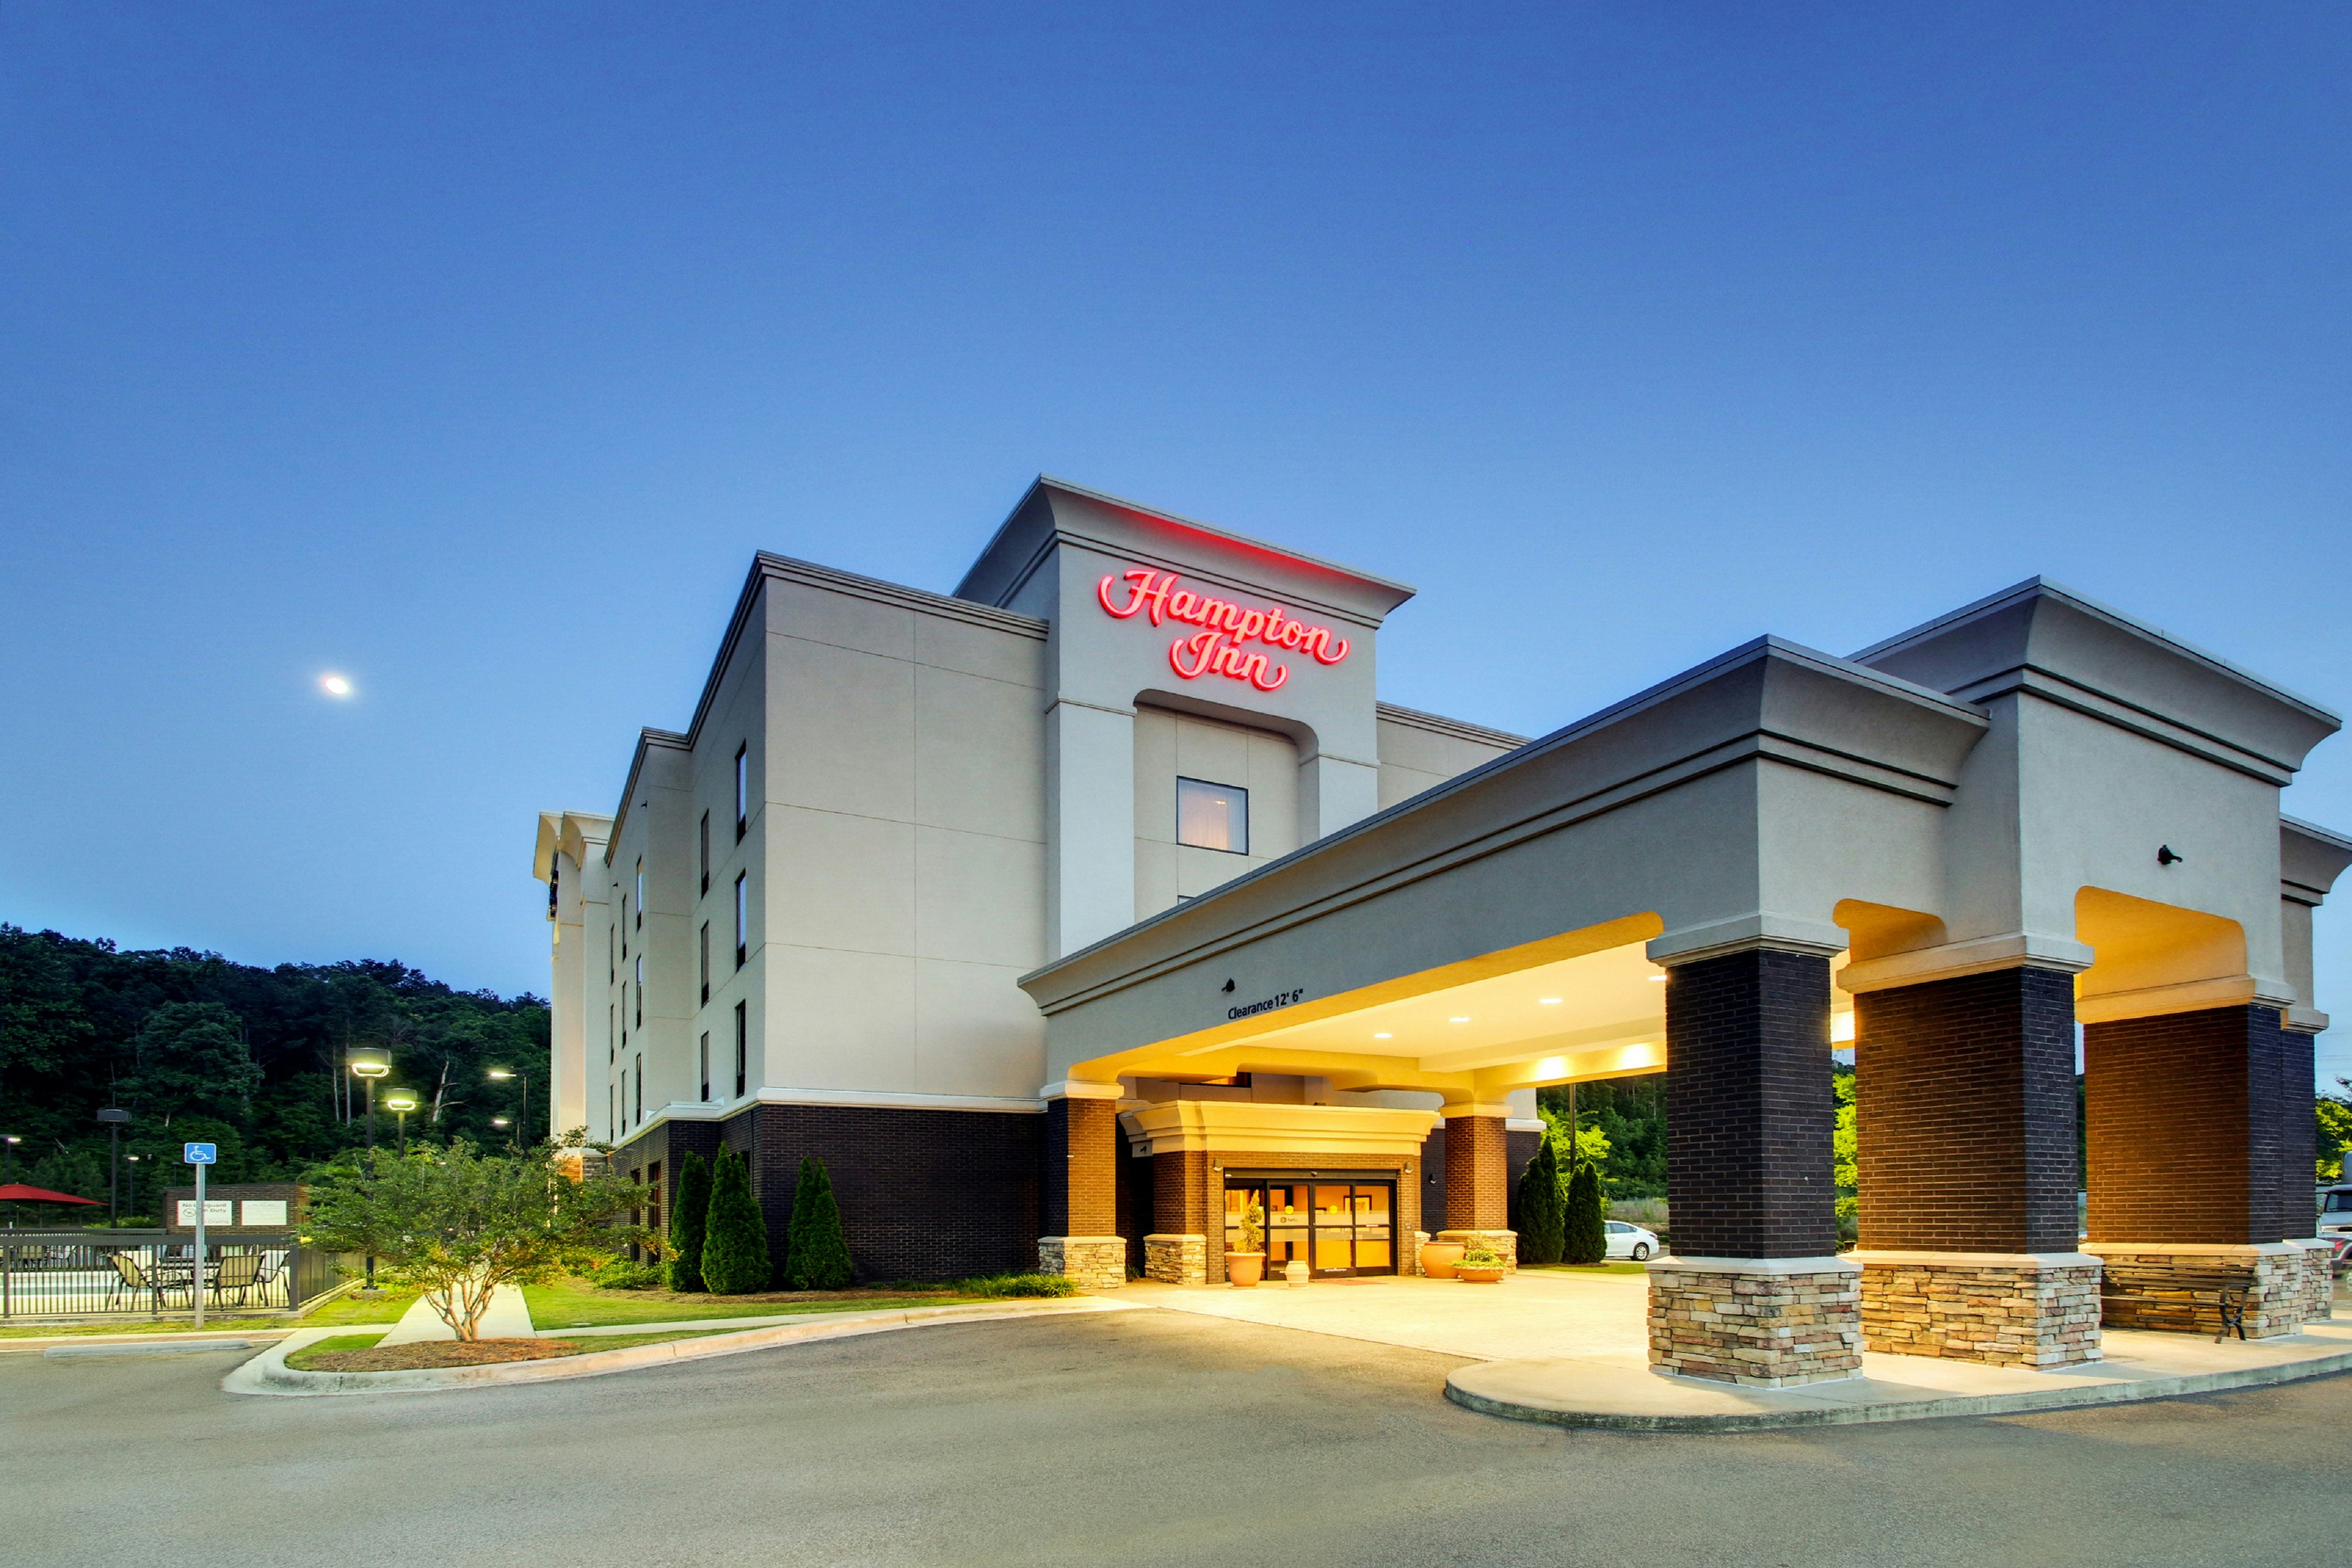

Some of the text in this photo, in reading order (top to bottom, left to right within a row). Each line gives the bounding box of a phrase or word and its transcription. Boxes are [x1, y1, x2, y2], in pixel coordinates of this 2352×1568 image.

[1098, 569, 1350, 665] Hampton
[1170, 631, 1287, 691] Inn
[1228, 988, 1304, 1019] Clearance 12' 6"
